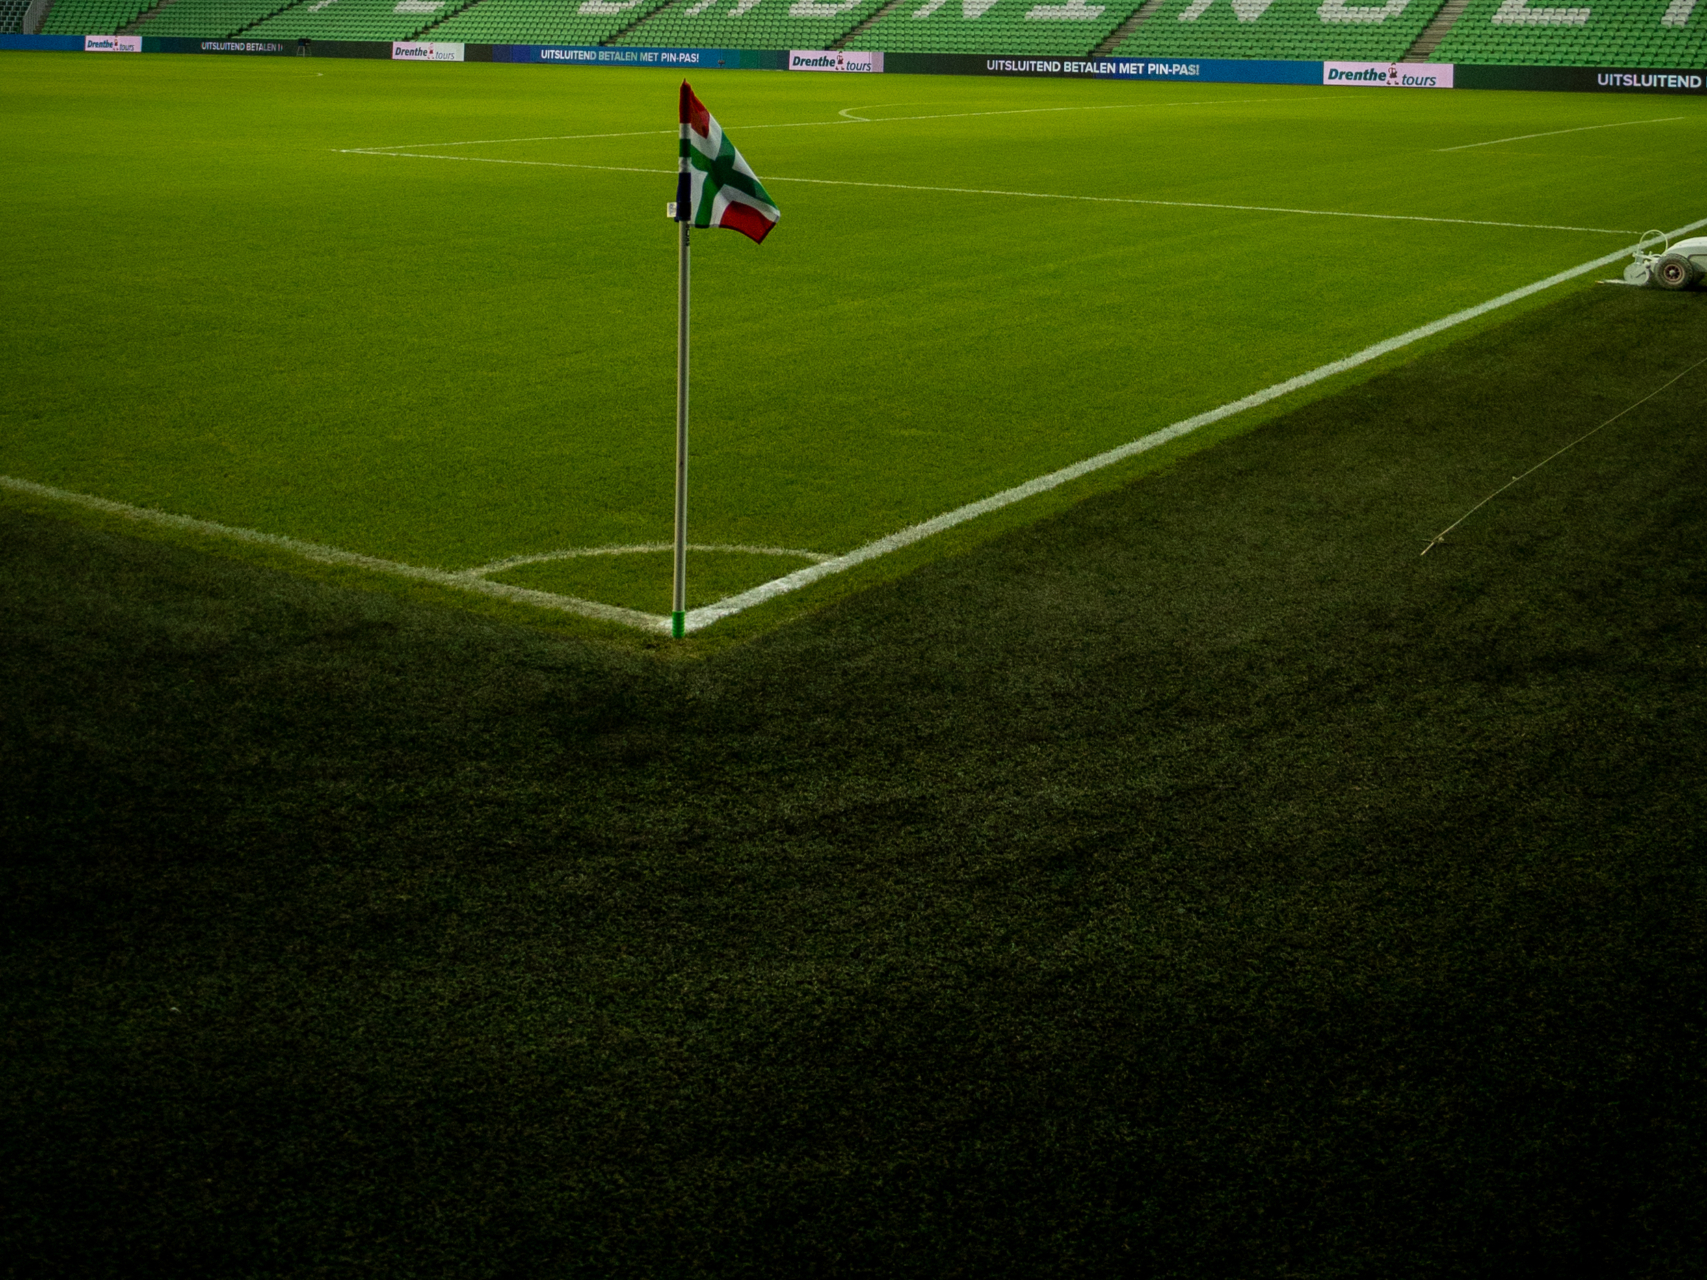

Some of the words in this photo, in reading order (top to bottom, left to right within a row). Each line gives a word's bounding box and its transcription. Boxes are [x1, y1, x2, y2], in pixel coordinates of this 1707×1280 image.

[87, 40, 113, 48] Drenthe
[119, 43, 134, 51] tours
[201, 42, 245, 51] UITSLUITEND
[246, 43, 276, 52] BETALEN
[395, 47, 428, 56] Drenthe
[435, 51, 455, 59] tours
[541, 49, 597, 60] UITSLUITEND
[598, 51, 637, 61] BETALEN
[640, 52, 659, 62] MET
[661, 53, 699, 63] PIN-PAS!
[792, 56, 836, 67] Drenthe
[846, 61, 871, 71] tours
[987, 59, 1061, 73] UITSLUITEND
[1064, 61, 1116, 74] BETALEN
[1119, 62, 1144, 75] MET
[1147, 63, 1200, 76] PIN-PAS!
[1328, 67, 1386, 81] Drenthe
[1402, 74, 1436, 86] tours
[1597, 73, 1702, 88] UITSLUITEND
